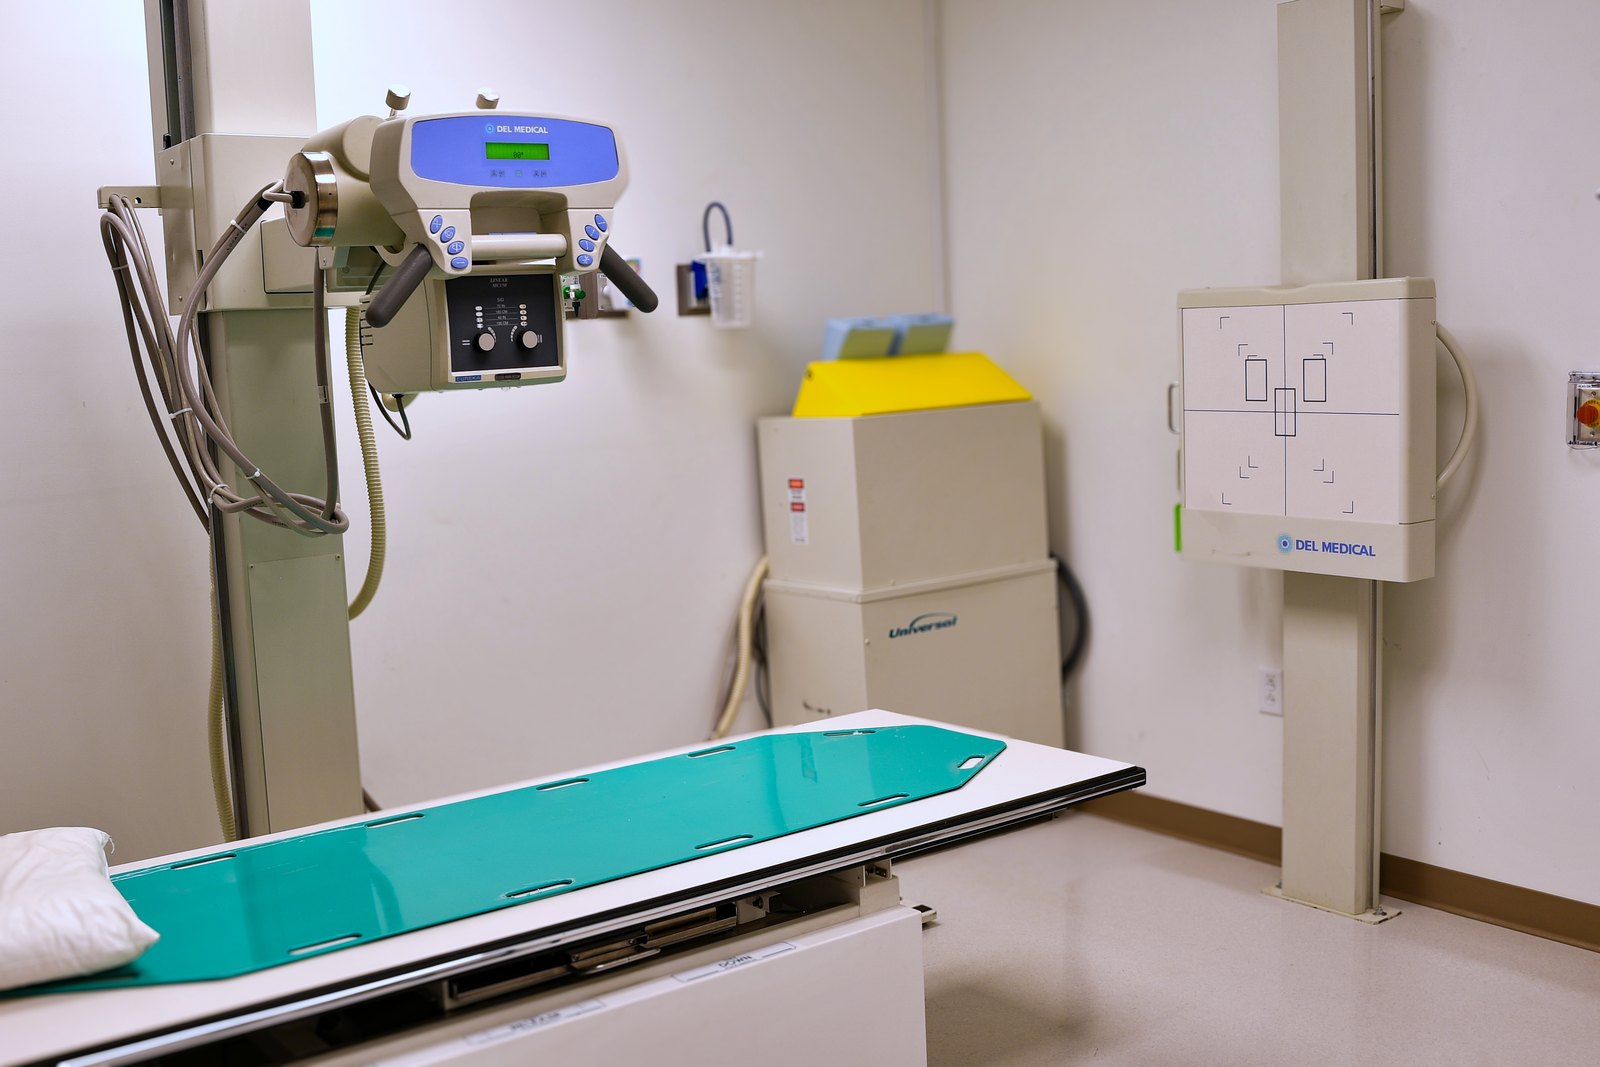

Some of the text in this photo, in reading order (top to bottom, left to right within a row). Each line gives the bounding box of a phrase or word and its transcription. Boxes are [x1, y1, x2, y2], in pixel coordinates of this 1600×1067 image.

[497, 125, 549, 134] DEL MEDICAL
[1295, 539, 1376, 557] DEL MEDICAL
[888, 615, 958, 639] Universal
[718, 955, 753, 969] DOWN
